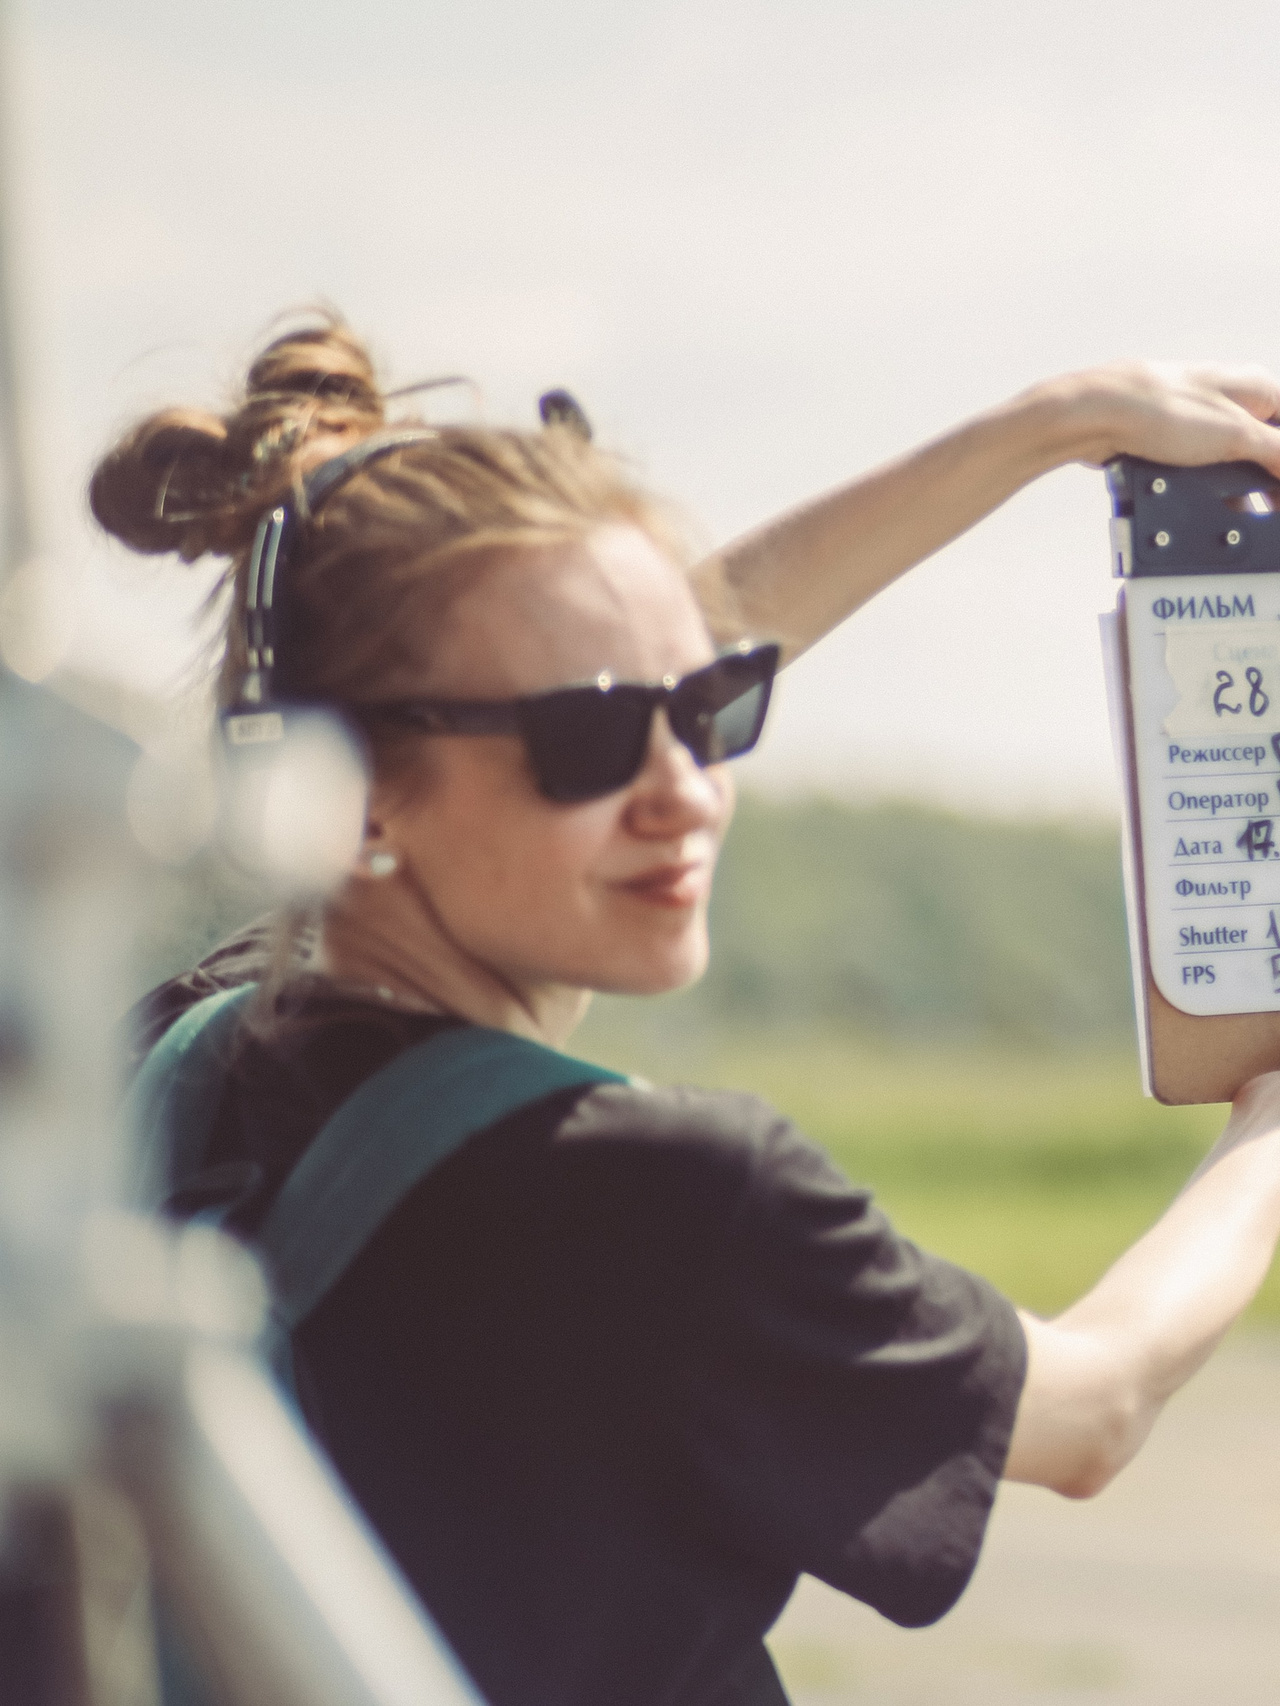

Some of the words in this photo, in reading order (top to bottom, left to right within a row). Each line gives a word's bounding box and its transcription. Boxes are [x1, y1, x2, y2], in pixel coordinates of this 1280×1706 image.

[1152, 594, 1256, 621] ФИЛЬМ
[1212, 666, 1270, 717] 28
[1168, 744, 1267, 766] Режиссер
[1168, 790, 1270, 815] Оператор
[1173, 837, 1223, 857] Дата
[1175, 878, 1251, 900] Фильтр
[1178, 925, 1248, 947] Shutter
[1181, 964, 1216, 985] FPS
